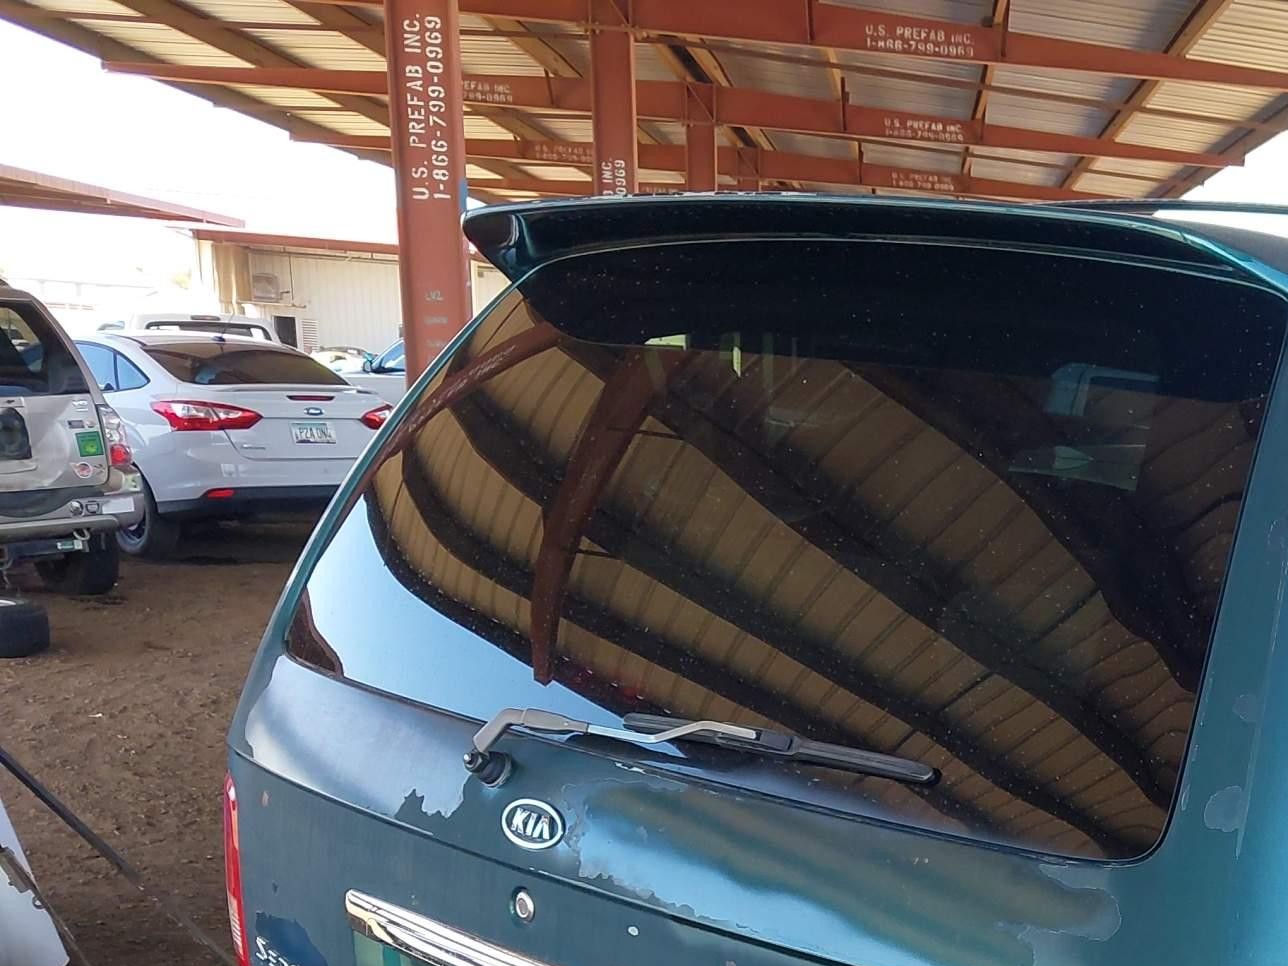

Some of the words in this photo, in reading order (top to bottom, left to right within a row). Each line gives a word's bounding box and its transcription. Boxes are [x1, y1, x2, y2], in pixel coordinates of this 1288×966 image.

[403, 14, 421, 53] INC.
[896, 26, 945, 41] PREFAB
[405, 65, 427, 148] PREFAB
[424, 15, 451, 199] 1-866-799-0969
[411, 161, 430, 200] U.S.
[511, 807, 550, 840] KIA
